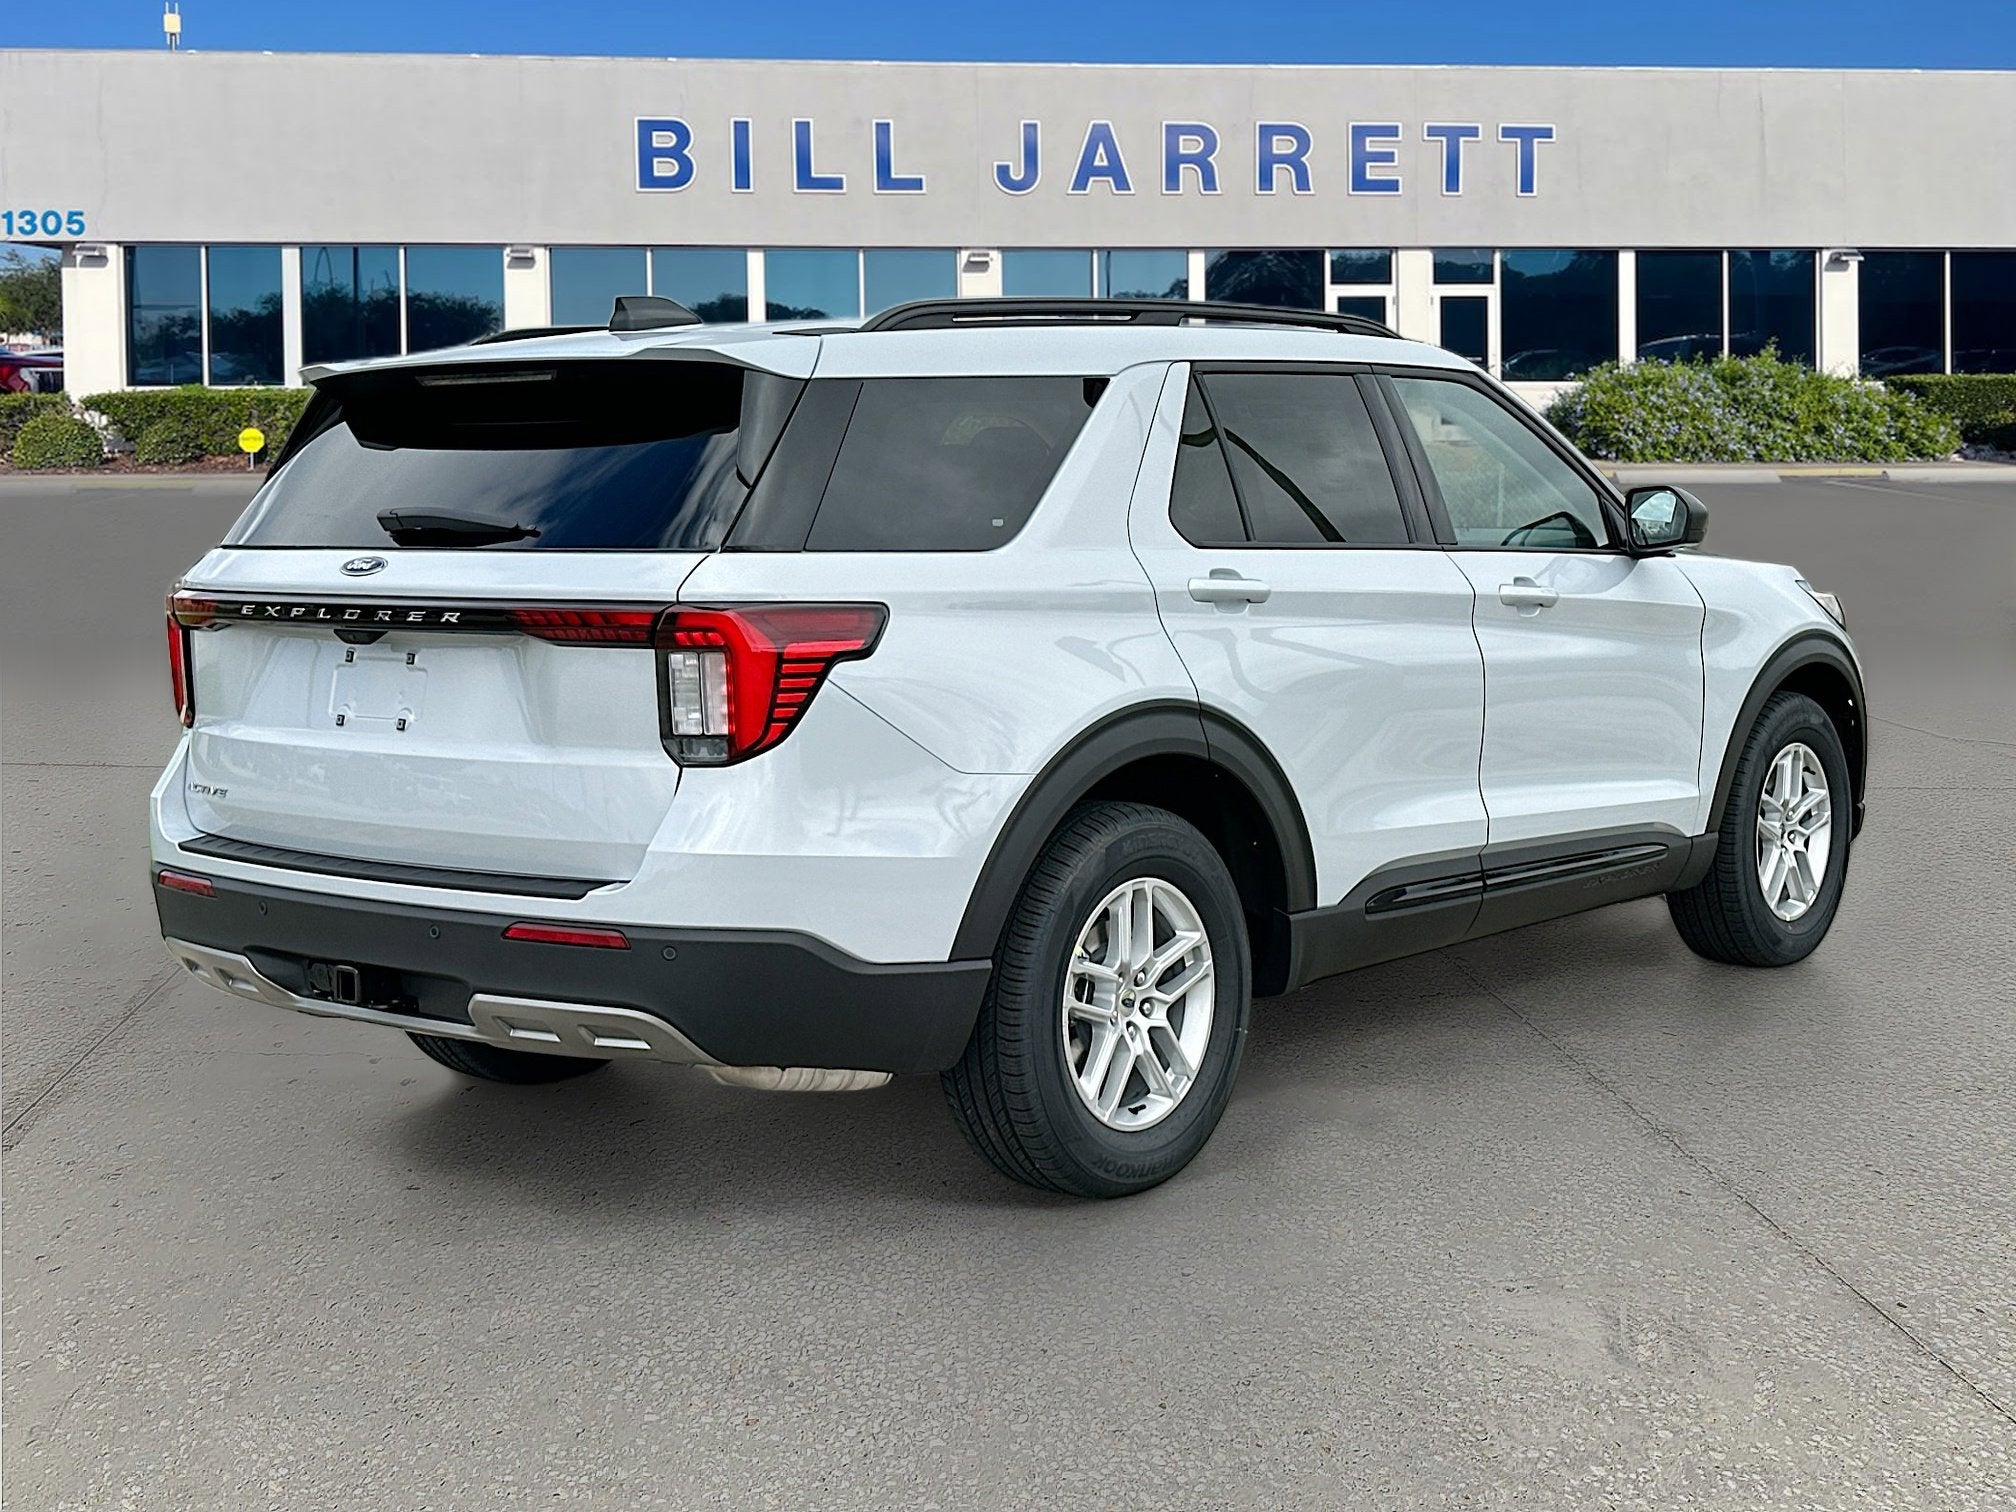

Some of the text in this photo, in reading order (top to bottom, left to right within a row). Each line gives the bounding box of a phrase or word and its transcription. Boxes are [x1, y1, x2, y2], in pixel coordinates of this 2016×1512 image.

[634, 115, 1556, 198] BILL JARRETT
[1, 209, 86, 236] 1305
[240, 604, 461, 623] EXPLORER
